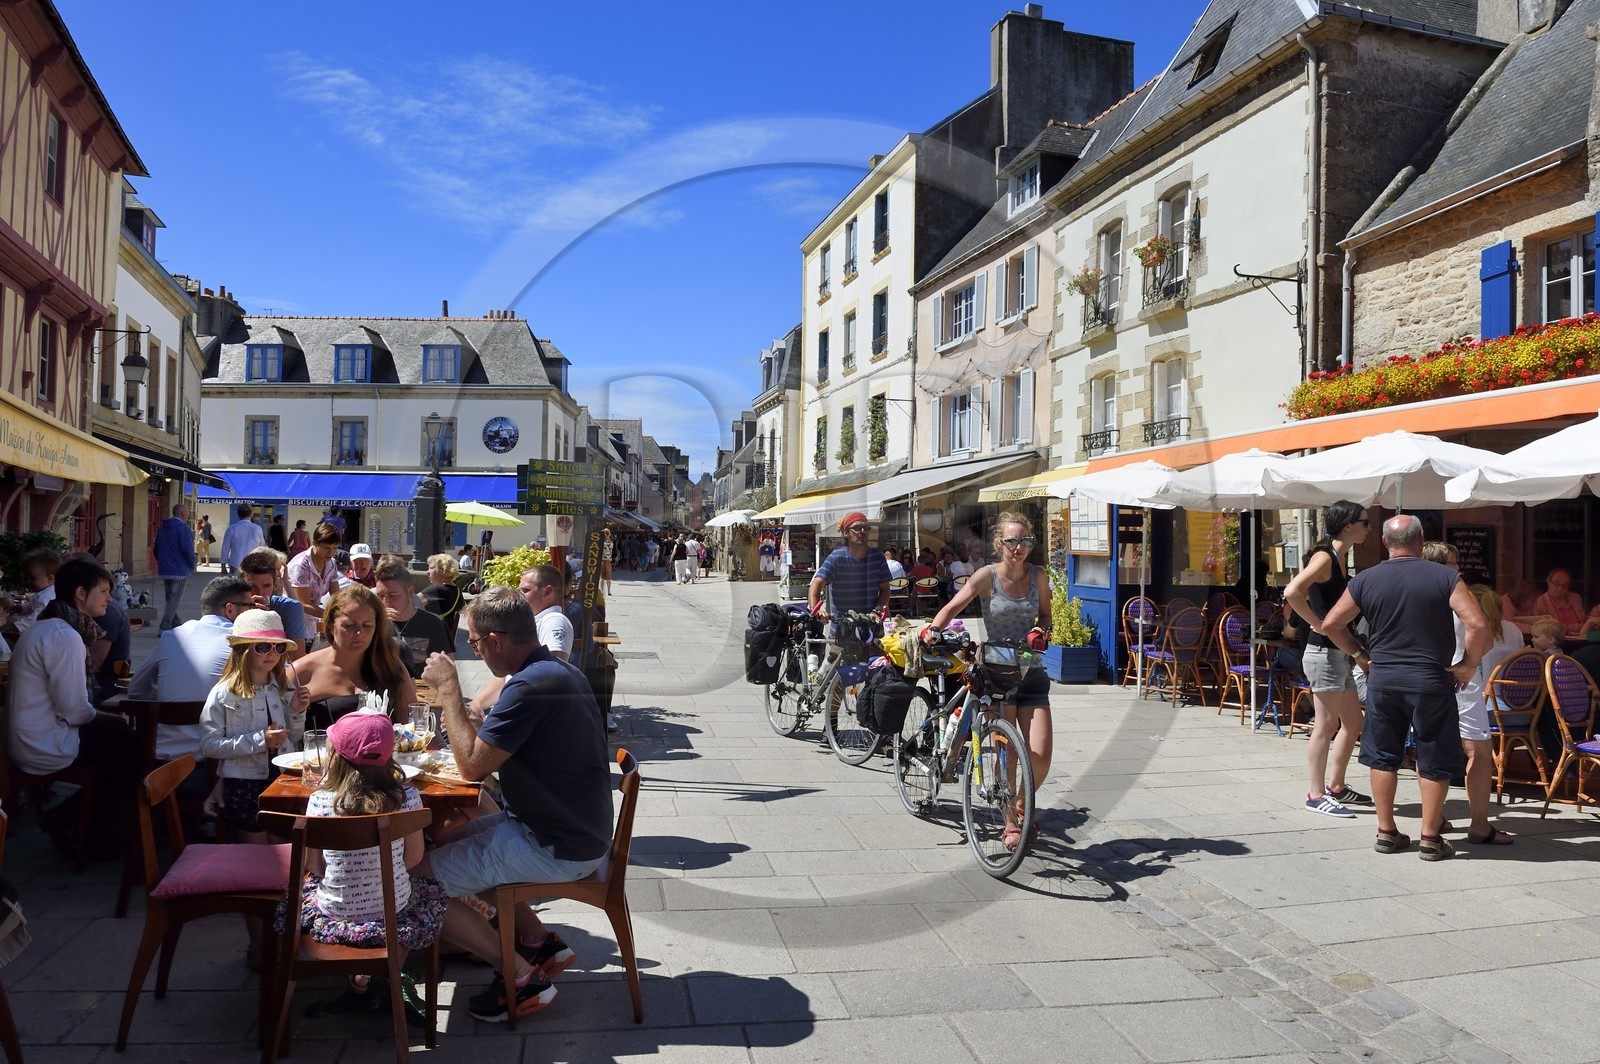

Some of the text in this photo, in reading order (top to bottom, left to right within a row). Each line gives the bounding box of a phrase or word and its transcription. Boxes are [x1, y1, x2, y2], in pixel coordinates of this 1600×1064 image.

[548, 461, 585, 473] Snack
[536, 473, 593, 488] Sandwichs
[535, 487, 595, 502] Hamburger
[288, 499, 338, 507] BISCUITERIE
[354, 500, 411, 508] CONCARNEAU
[546, 503, 584, 516] Frites
[583, 532, 601, 608] SANDWICHS
